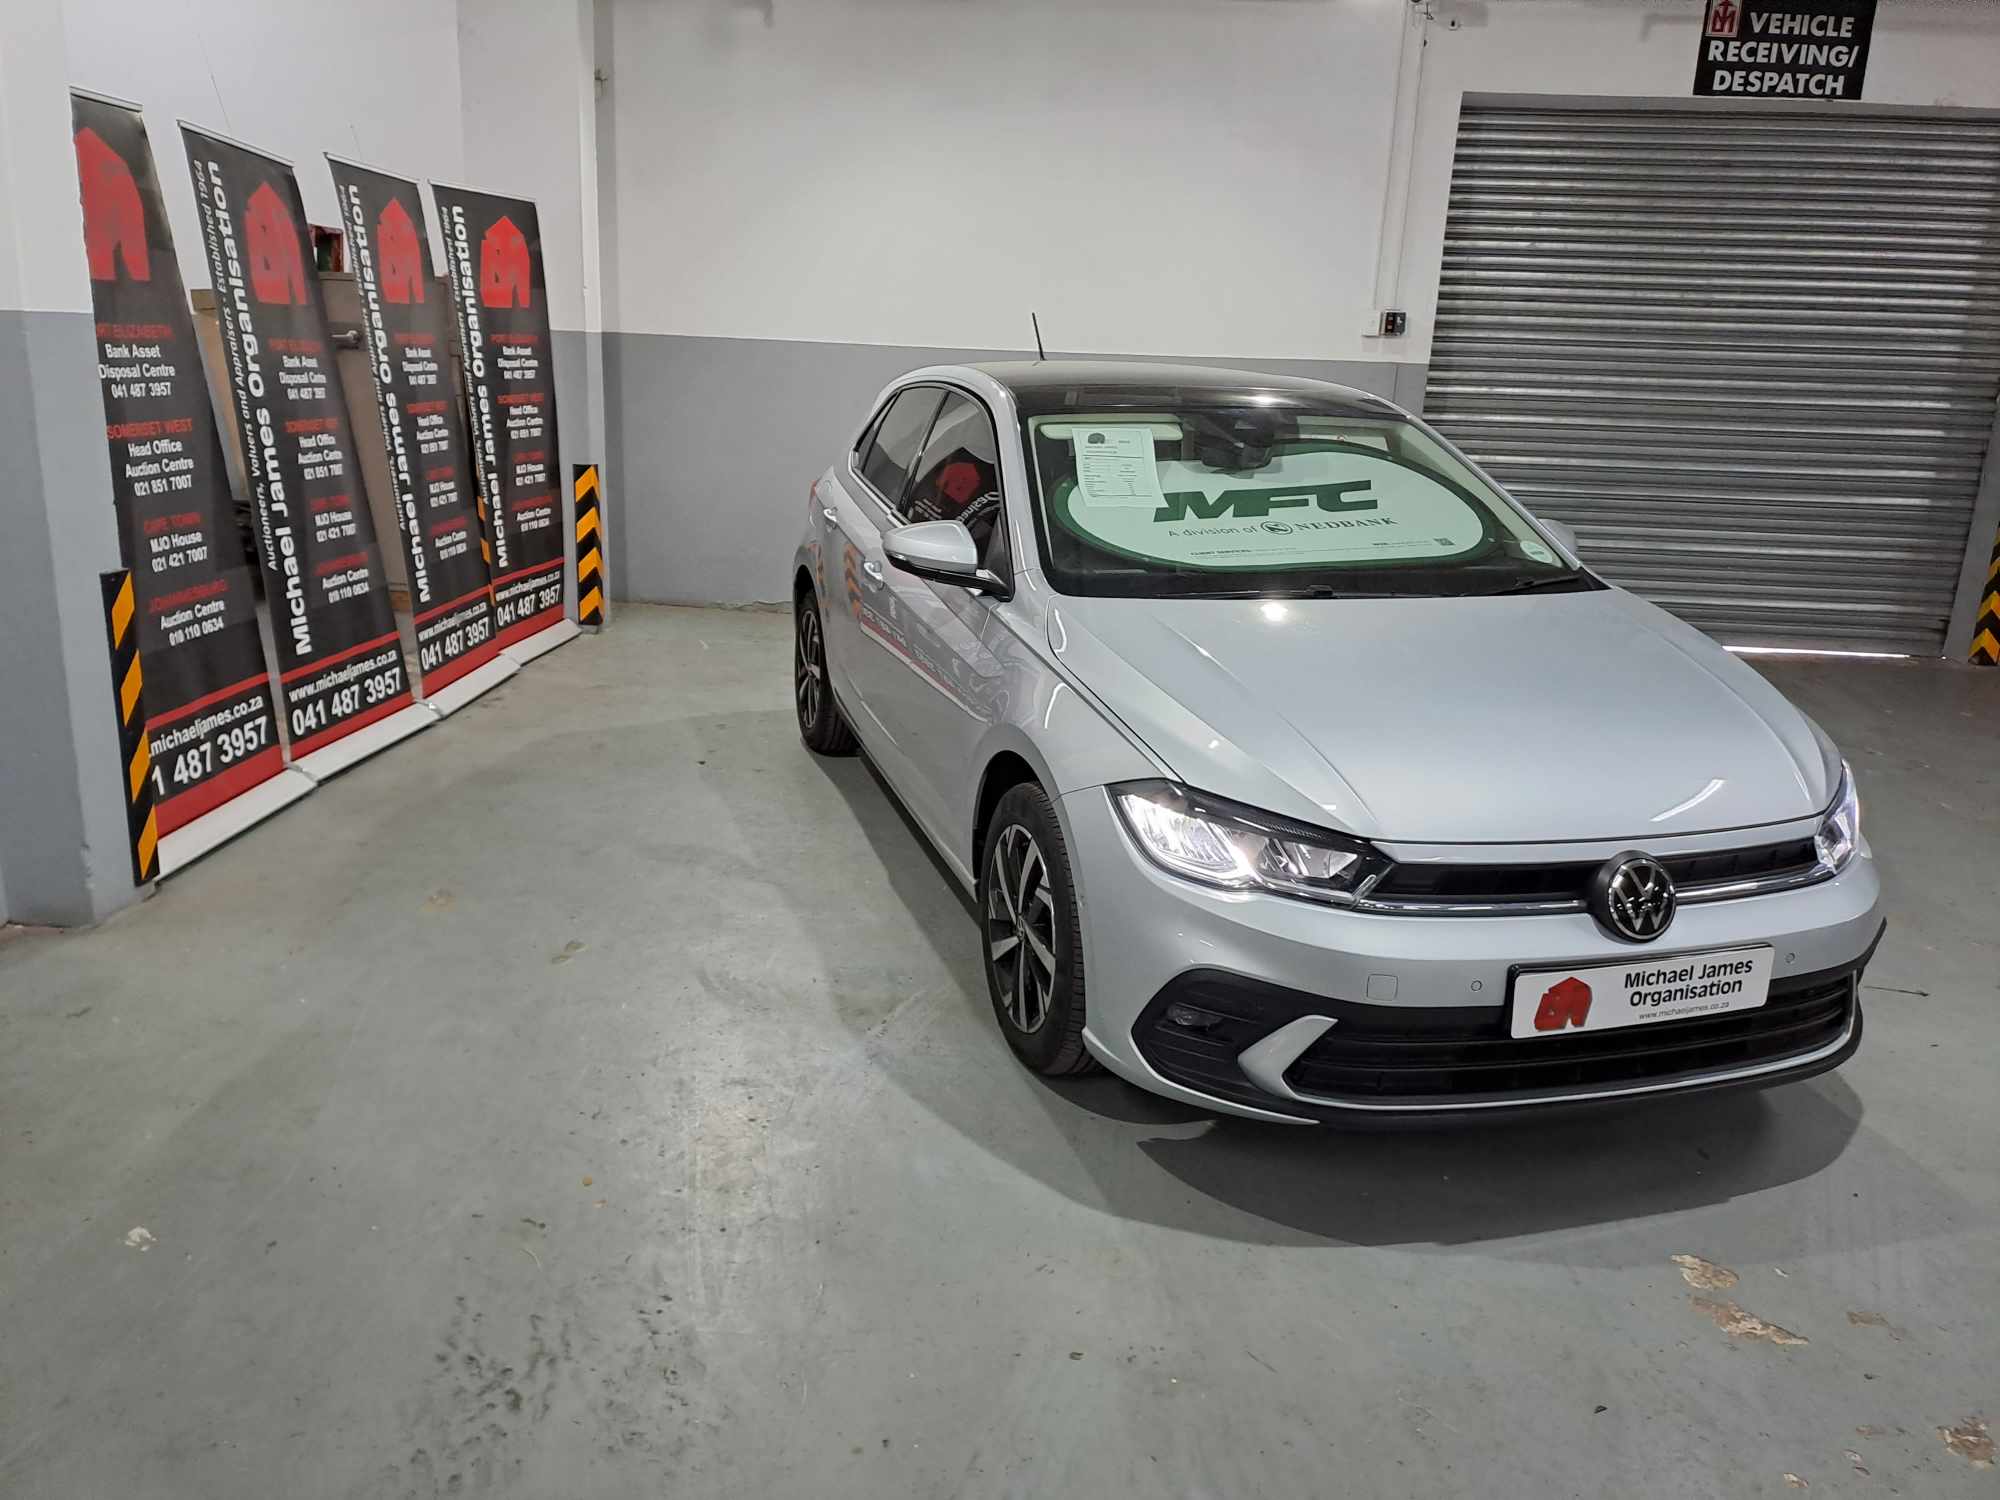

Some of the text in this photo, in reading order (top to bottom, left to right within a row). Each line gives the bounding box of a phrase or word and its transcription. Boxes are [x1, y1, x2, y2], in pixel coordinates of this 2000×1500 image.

[1750, 12, 1855, 38] VEHICLE
[1707, 40, 1859, 68] RECEIVING/
[1712, 70, 1845, 96] DESPATCH
[203, 204, 226, 294] Established
[105, 344, 161, 358] Bank Asset
[223, 306, 245, 387] Appraisers
[98, 363, 176, 380] Disposal Centre
[111, 382, 171, 398] 041 487 3957
[348, 184, 431, 603] Michael James Organisation
[452, 206, 508, 568] Michael James Organisation
[207, 160, 312, 656] Michael James Organisation
[237, 389, 250, 418] and
[128, 439, 183, 457] Head Office
[244, 421, 261, 477] Valuers
[125, 458, 194, 478] Auction Centre
[134, 475, 192, 496] 021 851 7007
[1153, 479, 1378, 522] MFC
[256, 482, 278, 571] Auctioneers,
[1183, 527, 1241, 537] division
[1243, 525, 1258, 533] of
[1294, 517, 1398, 531] NEDBANK
[150, 532, 202, 553] MJO House
[152, 546, 207, 573] 021 421 7007
[161, 600, 225, 630] Auction Centre
[497, 584, 560, 626] 041 487 3957
[421, 617, 489, 671] 041 487 3957
[289, 650, 397, 702] www.michaeljames.co.za
[292, 667, 401, 736] 041 487 3957
[148, 696, 263, 758] .michaeljames.co.za
[174, 742, 212, 784] 487
[217, 716, 267, 764] 3957
[1624, 960, 1753, 988] Michael James
[1630, 980, 1743, 1007] Organisation
